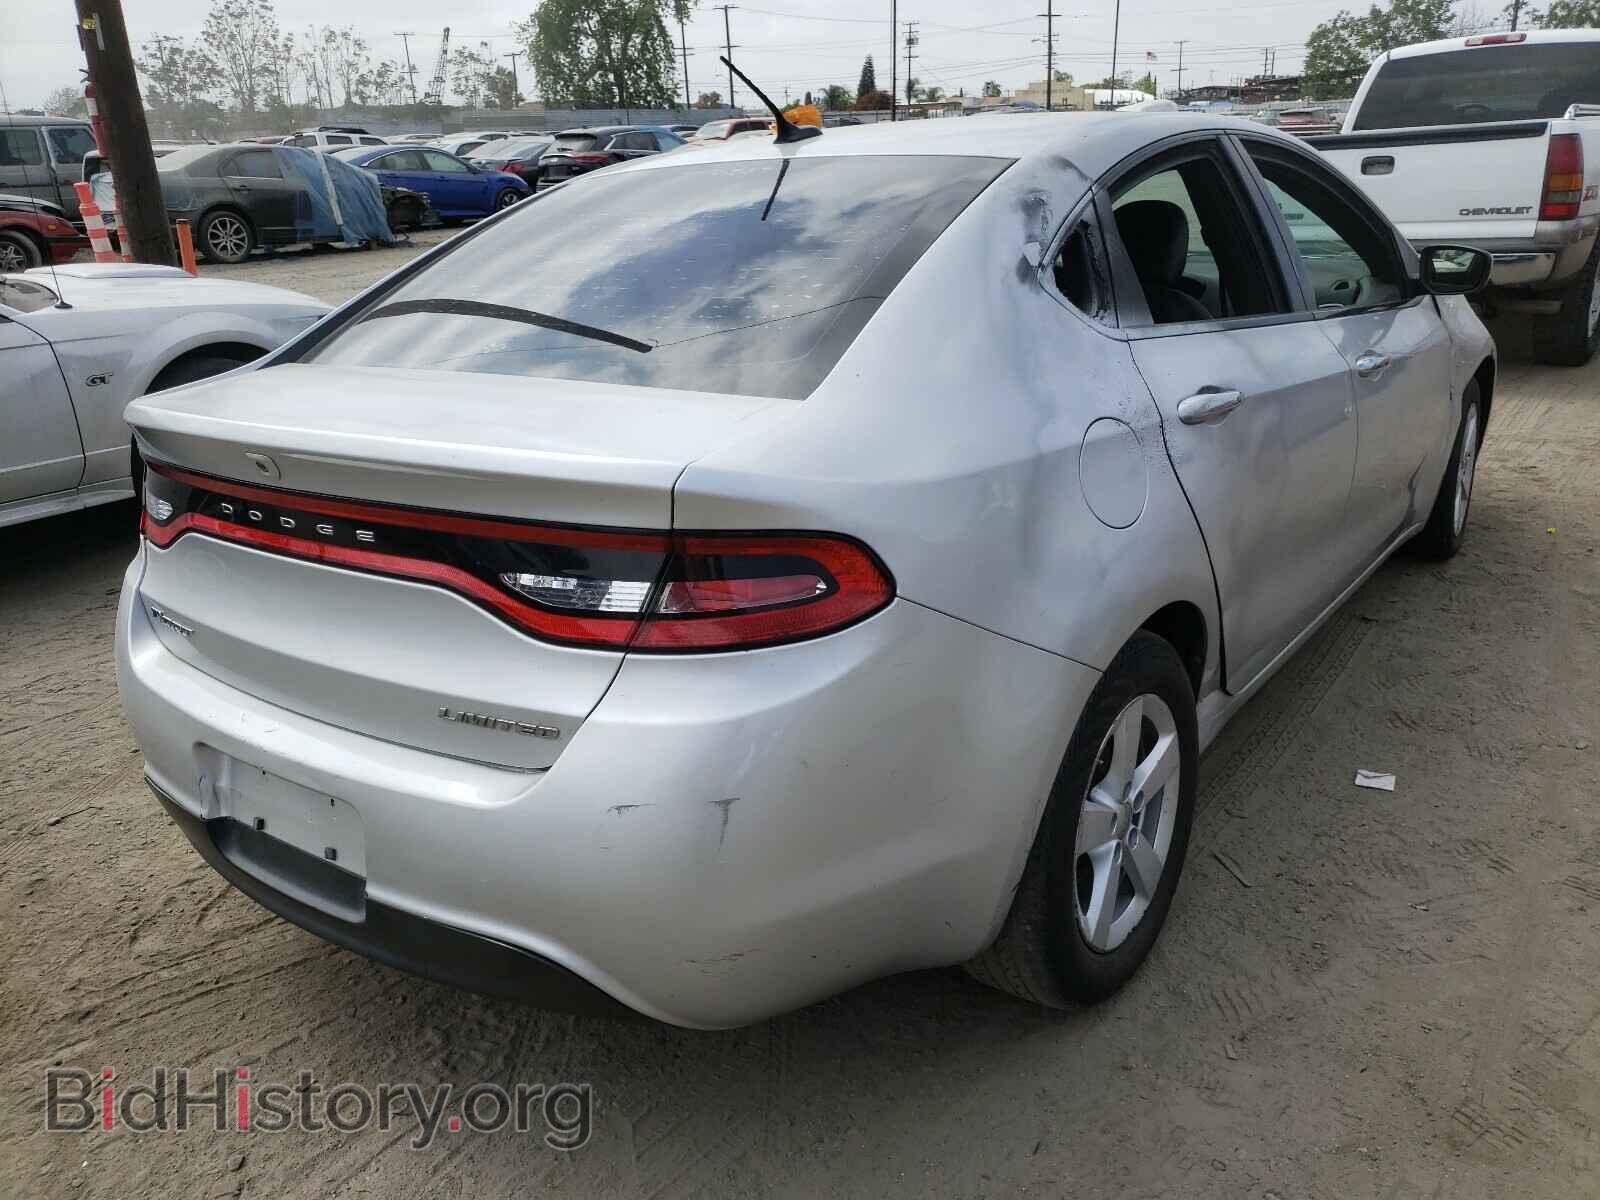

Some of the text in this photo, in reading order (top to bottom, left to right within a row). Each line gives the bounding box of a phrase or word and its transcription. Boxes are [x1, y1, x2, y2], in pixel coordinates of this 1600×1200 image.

[1458, 205, 1533, 216] CHEVROLET
[85, 372, 113, 388] GT
[220, 502, 377, 543] DODGE
[439, 706, 561, 739] LIMITED
